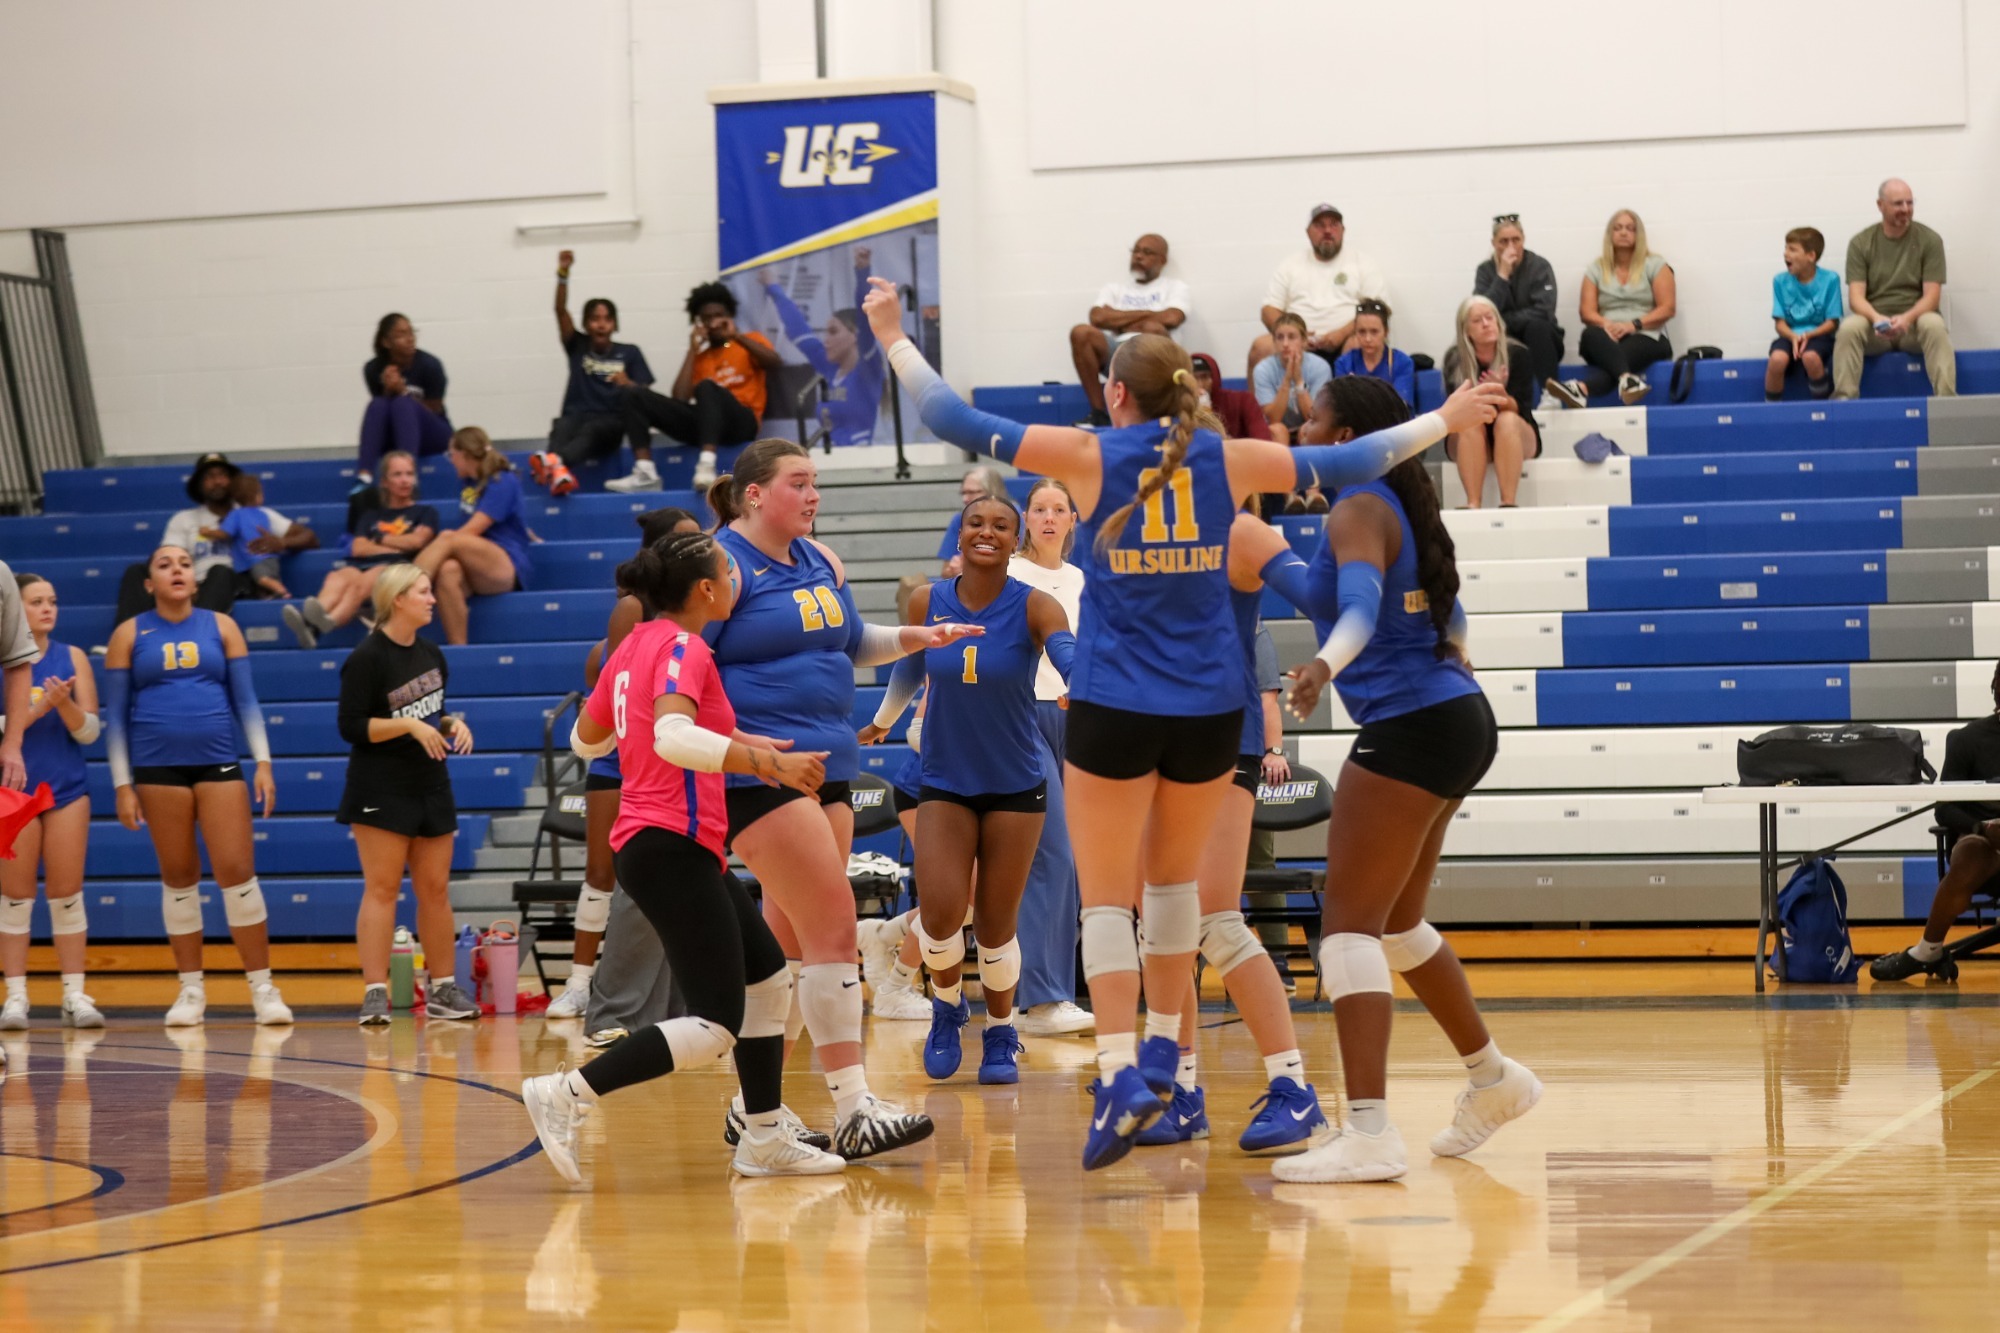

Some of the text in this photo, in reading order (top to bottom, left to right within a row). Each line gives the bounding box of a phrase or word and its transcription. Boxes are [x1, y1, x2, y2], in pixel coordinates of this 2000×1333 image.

[780, 122, 880, 188] UC
[1138, 467, 1199, 543] 11
[1108, 545, 1224, 574] URSULINE
[793, 586, 844, 632] 20
[162, 641, 199, 670] 13
[962, 646, 978, 684] 1
[392, 688, 444, 720] ARROW
[613, 670, 630, 739] 6
[1256, 783, 1315, 798] RSULINE
